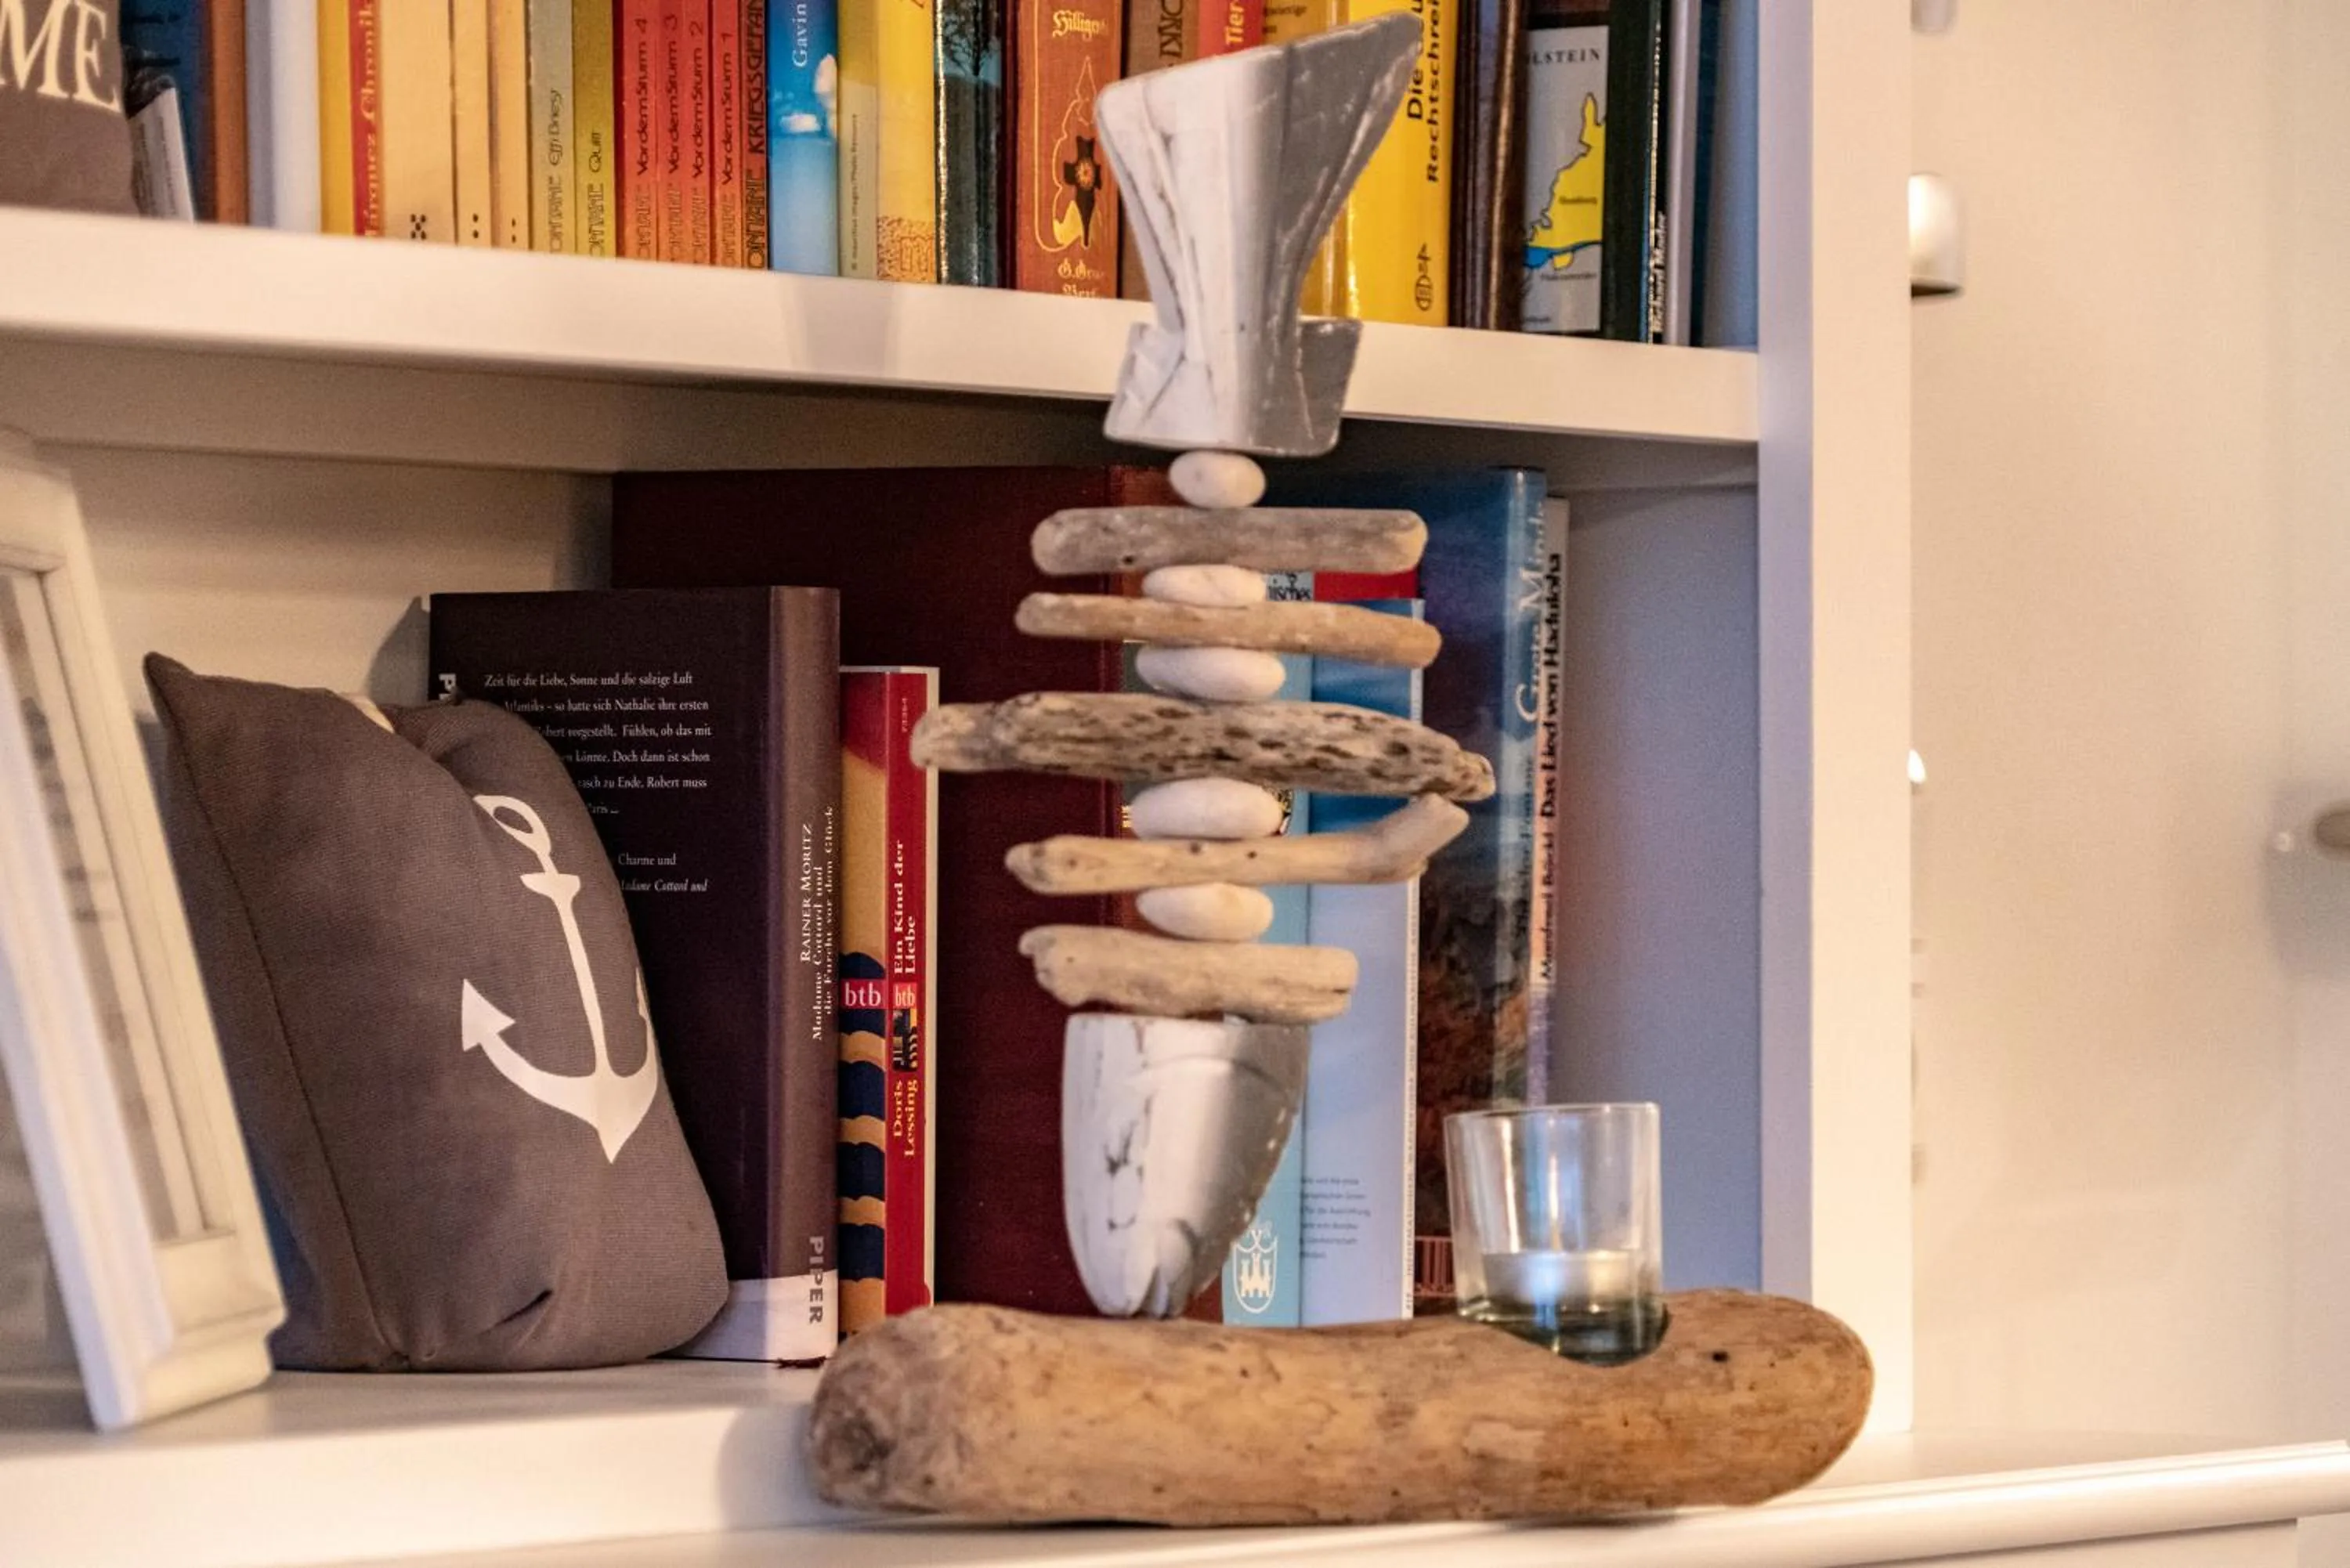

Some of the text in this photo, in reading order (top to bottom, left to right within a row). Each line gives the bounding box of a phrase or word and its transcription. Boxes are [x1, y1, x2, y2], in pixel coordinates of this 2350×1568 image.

[634, 19, 647, 34] 4
[663, 15, 678, 31] 3
[689, 21, 703, 36] 2
[792, 2, 808, 67] Gavin
[721, 34, 732, 44] 1
[1407, 68, 1424, 121] Die
[484, 671, 693, 688] Zeit für die Liebe, Sonne und die salzige Luft
[555, 703, 565, 712] so
[568, 698, 591, 712] hatte
[593, 698, 612, 711] sich
[614, 697, 656, 711] Nathalie
[658, 697, 677, 710] ihre
[679, 700, 710, 711] ersten
[1548, 674, 1560, 715] von
[623, 723, 659, 739] Fühlen,
[660, 723, 673, 736] ob
[676, 723, 692, 736] das
[695, 723, 712, 736] mit
[613, 749, 638, 763] Doch
[640, 749, 665, 763] dann
[667, 749, 680, 763] ist
[682, 749, 711, 763] schon
[1541, 722, 1557, 772] Lied
[603, 779, 616, 789] zu
[618, 775, 644, 789] Ende.
[646, 774, 680, 789] Robert
[682, 778, 708, 789] muss
[1540, 778, 1556, 818] Das
[617, 851, 677, 866] Charme und
[690, 878, 708, 893] und
[825, 862, 833, 894] dem
[799, 823, 813, 963] RAINER MORITZ
[893, 840, 903, 974] Ein Kind der
[812, 867, 824, 1041] Madame Cottard und
[825, 933, 833, 985] Furcht
[904, 915, 916, 974] Liebe
[825, 992, 833, 1015] die
[845, 981, 882, 1007] btb
[895, 984, 916, 1007] btb
[892, 1079, 903, 1138] Doris
[903, 1078, 917, 1157] Lessing
[808, 1235, 824, 1325] PIPER
